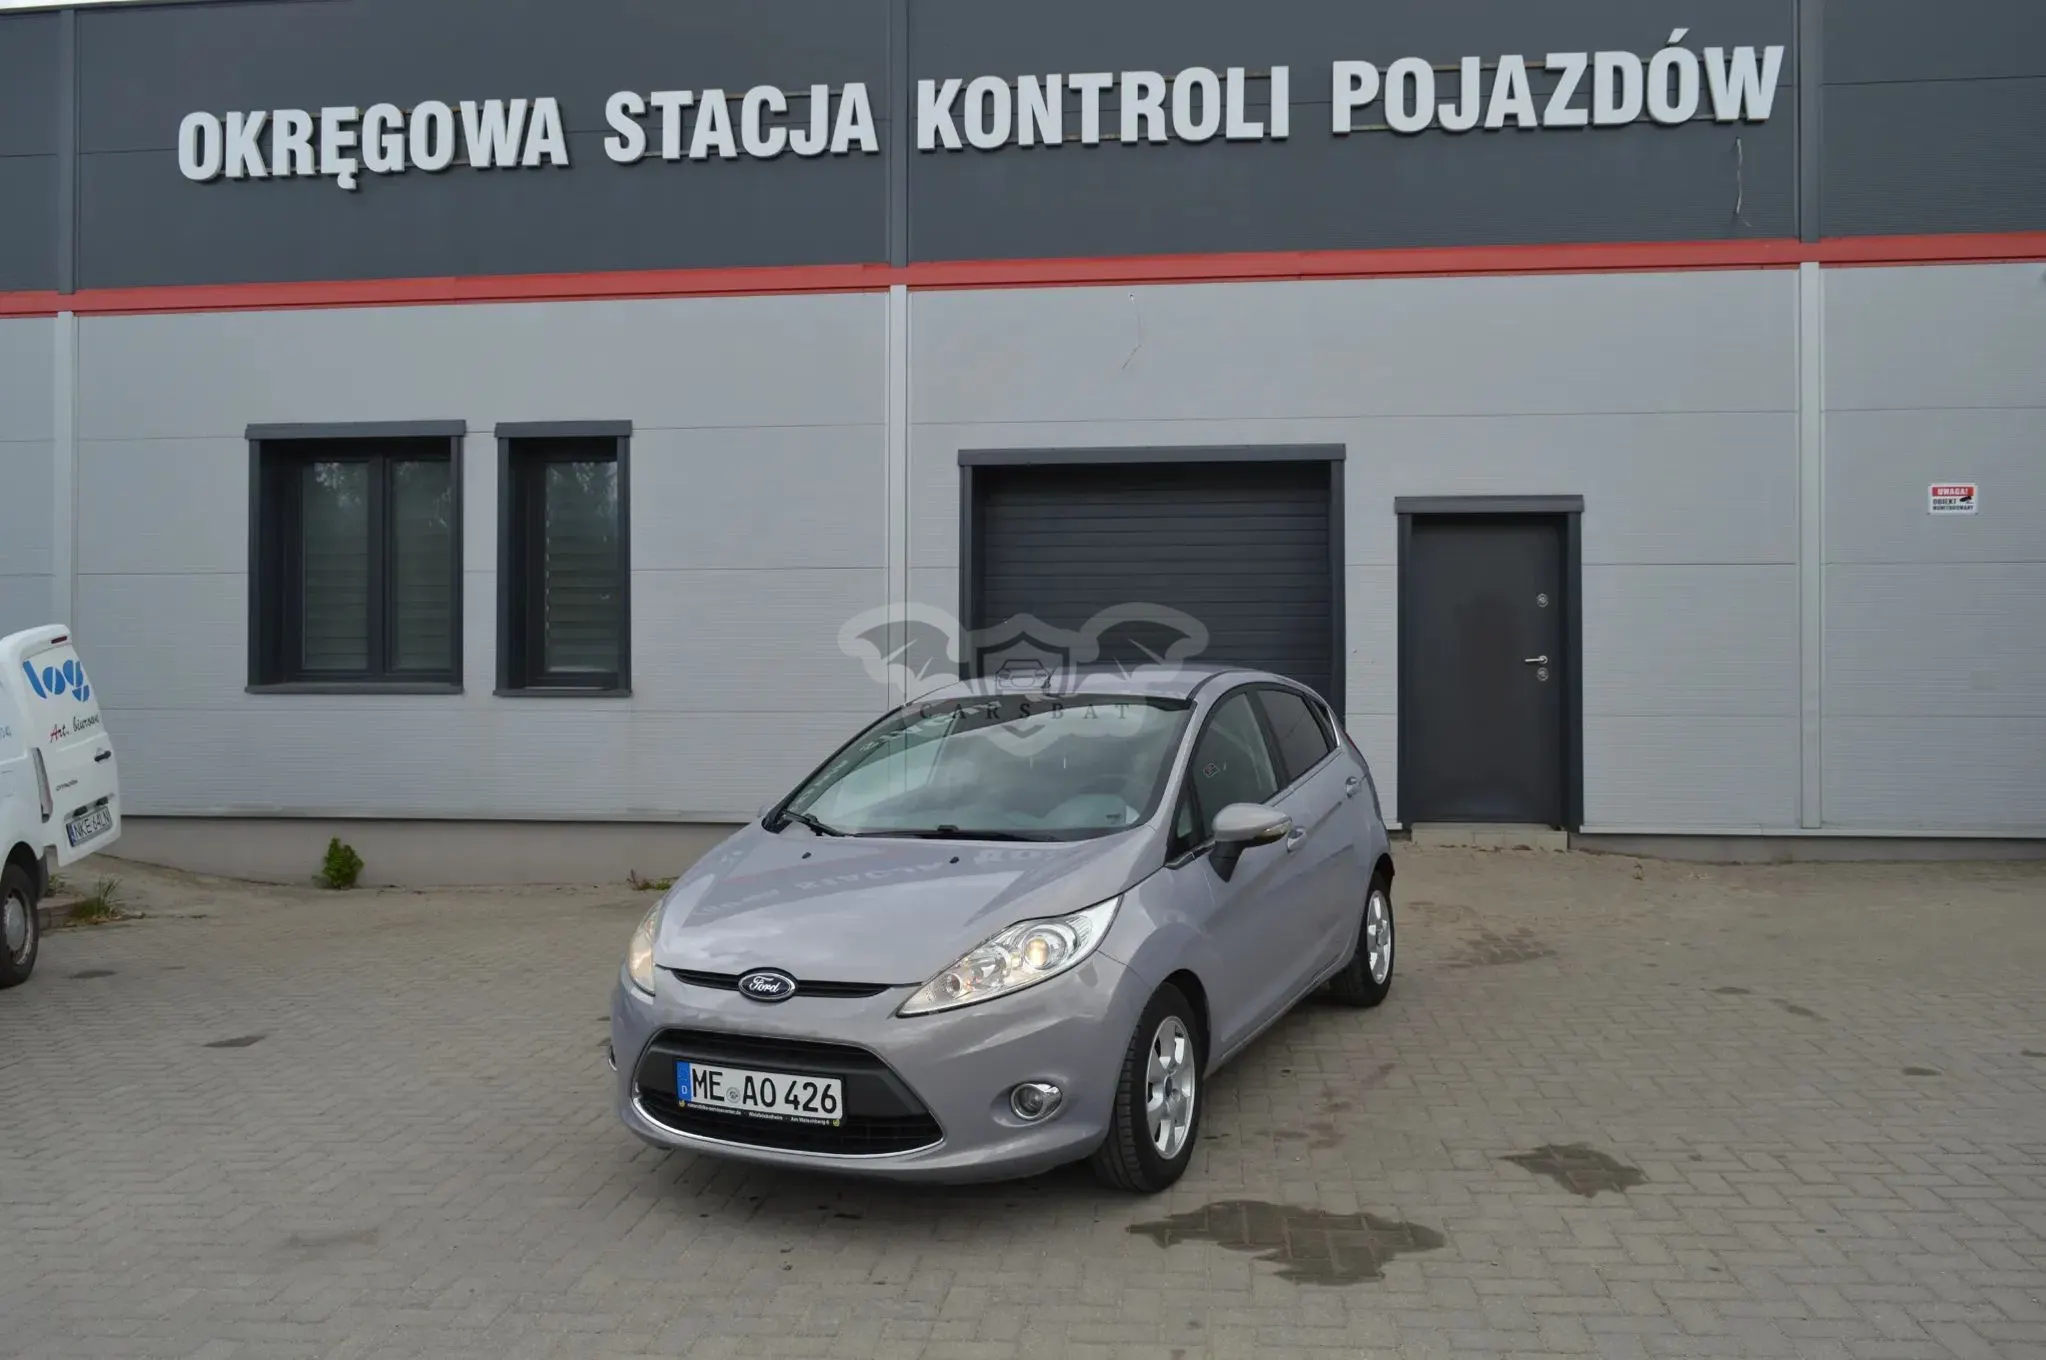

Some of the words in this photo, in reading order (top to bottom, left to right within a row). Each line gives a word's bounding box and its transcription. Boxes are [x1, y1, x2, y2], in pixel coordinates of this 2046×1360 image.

[177, 97, 570, 190] OKRĘGOWA
[603, 82, 880, 163] STACJA
[917, 66, 1289, 150] KONTROLI
[1332, 28, 1784, 133] POJAZDÓW
[1937, 487, 1969, 496] UWAGA!
[748, 975, 782, 993] Ford
[692, 1068, 725, 1102] ME
[742, 1075, 777, 1108] AO
[784, 1080, 837, 1114] 426
